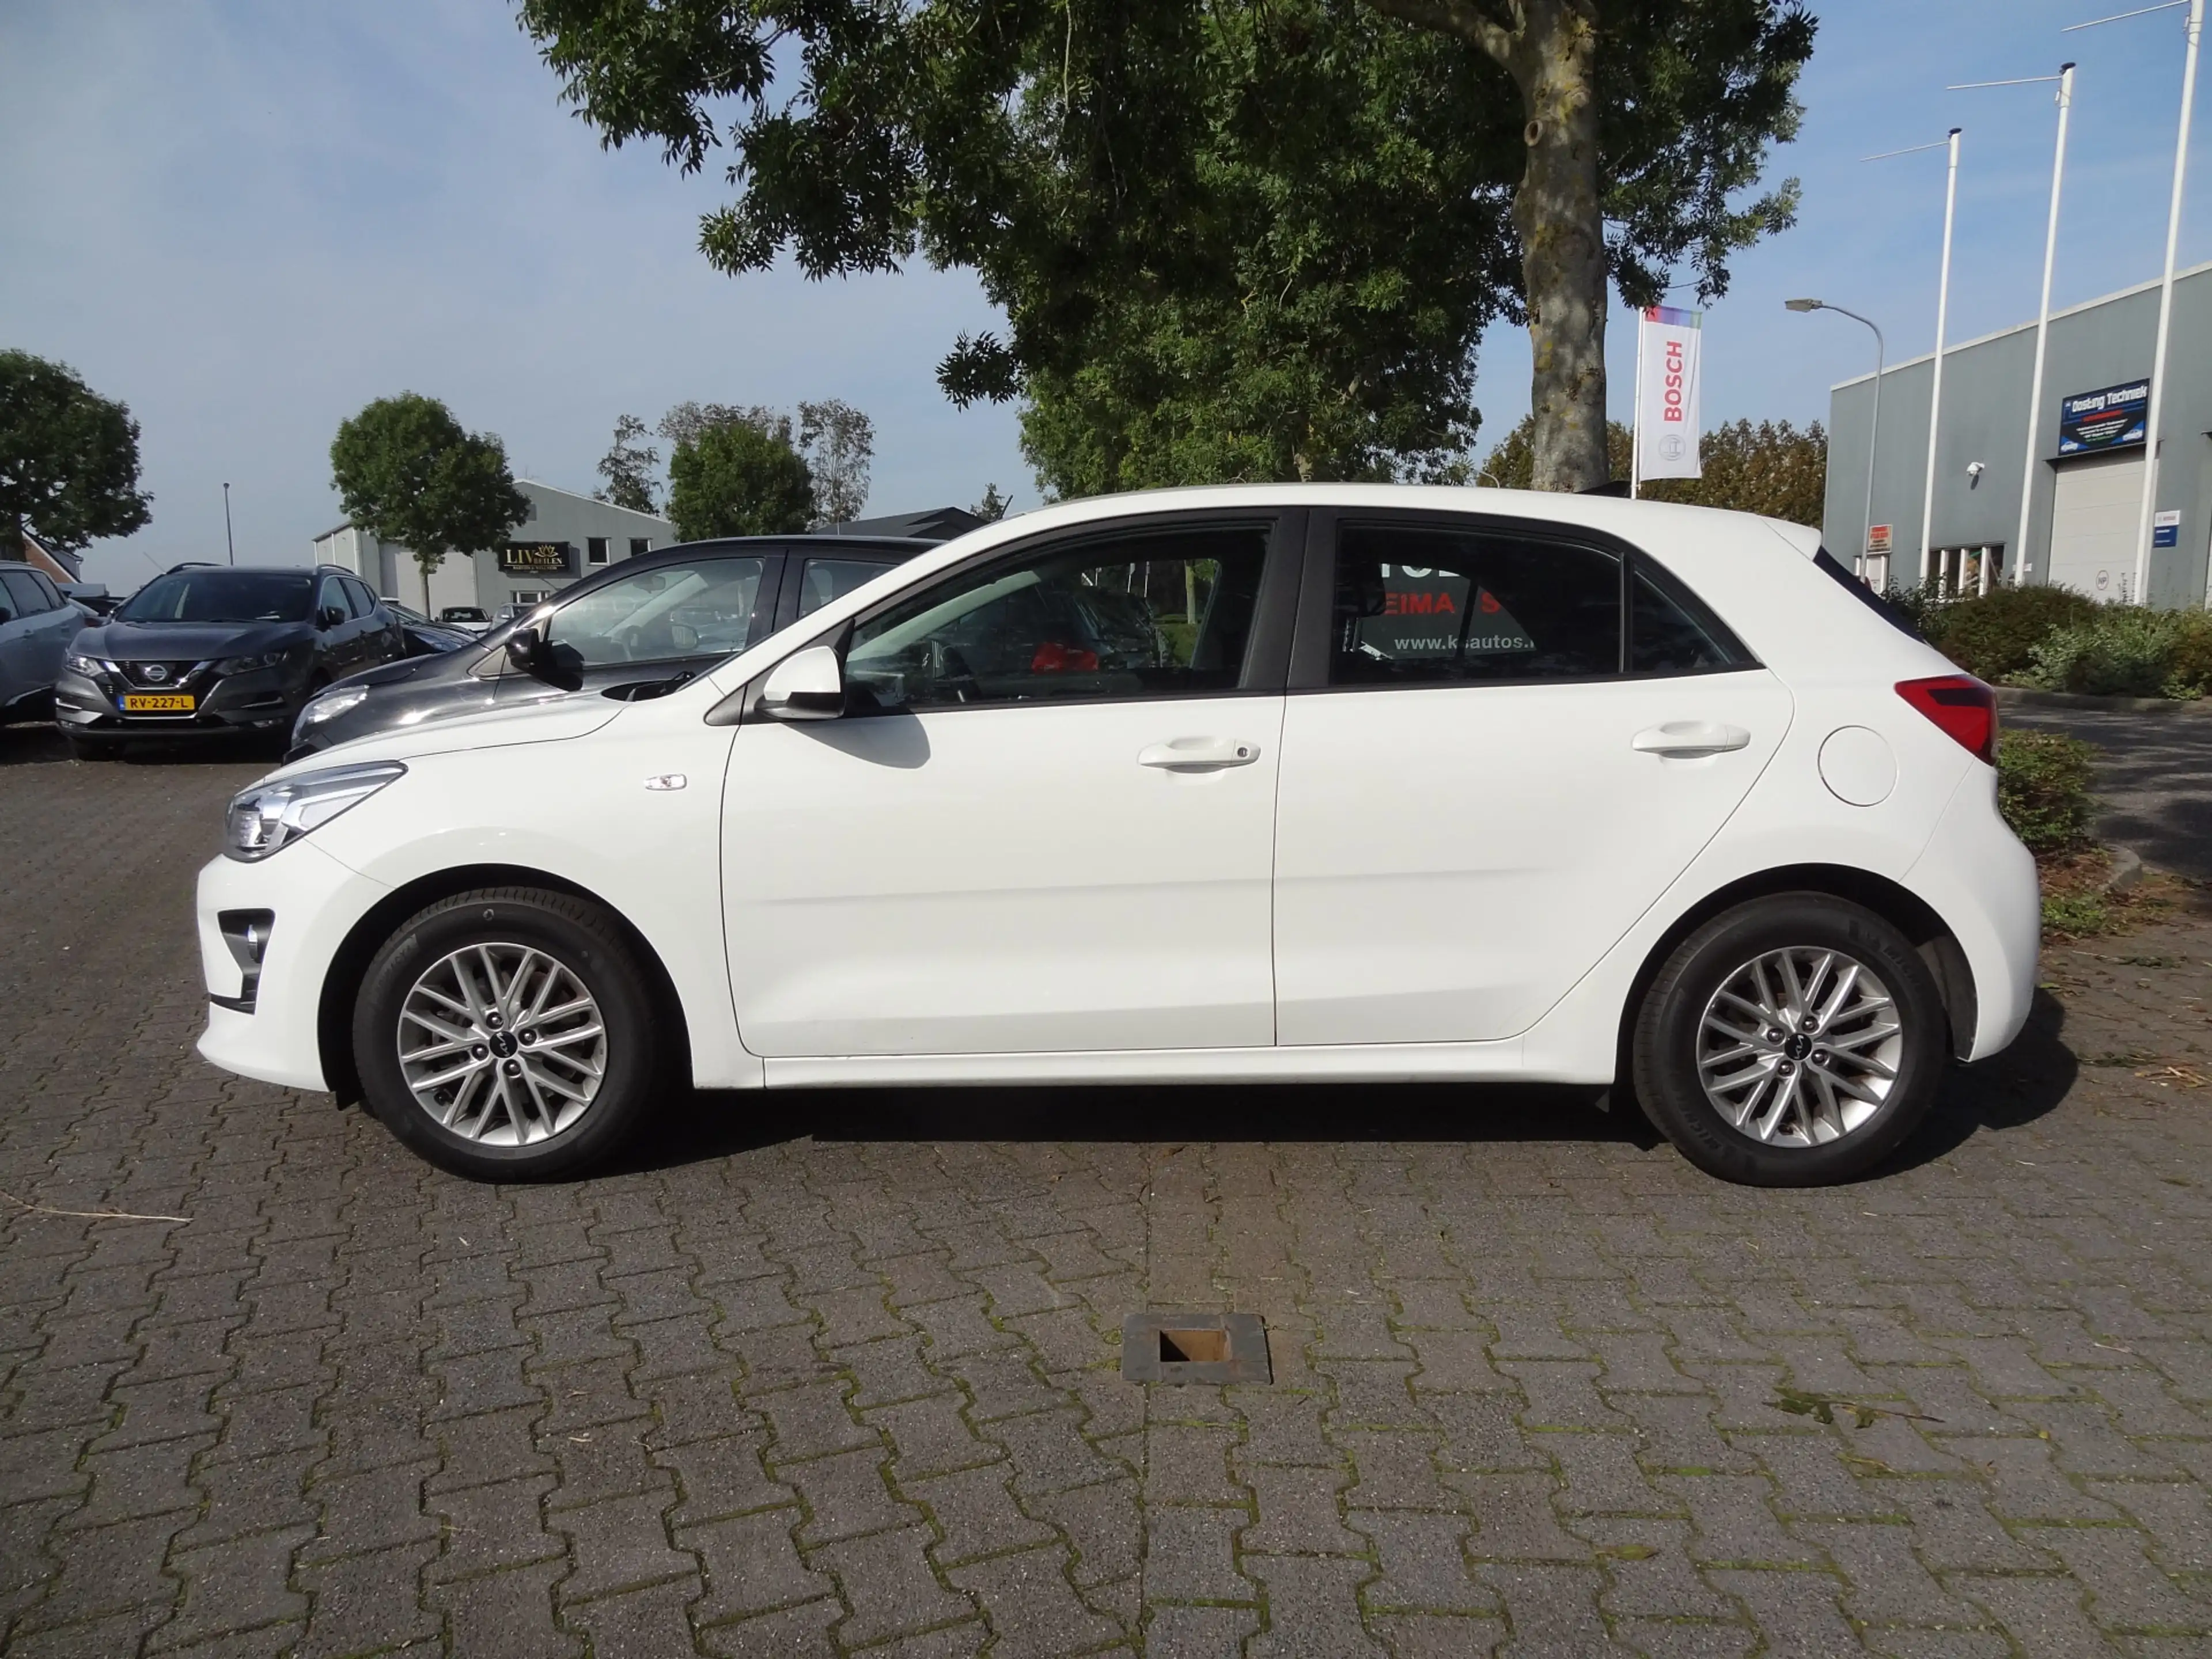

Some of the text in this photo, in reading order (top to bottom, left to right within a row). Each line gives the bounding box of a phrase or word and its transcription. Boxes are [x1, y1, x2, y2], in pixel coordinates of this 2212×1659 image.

[1664, 341, 1682, 422] BOSCH
[2107, 385, 2147, 405] Techniek
[506, 549, 535, 564] LIV
[130, 698, 189, 708] RV-227-L
